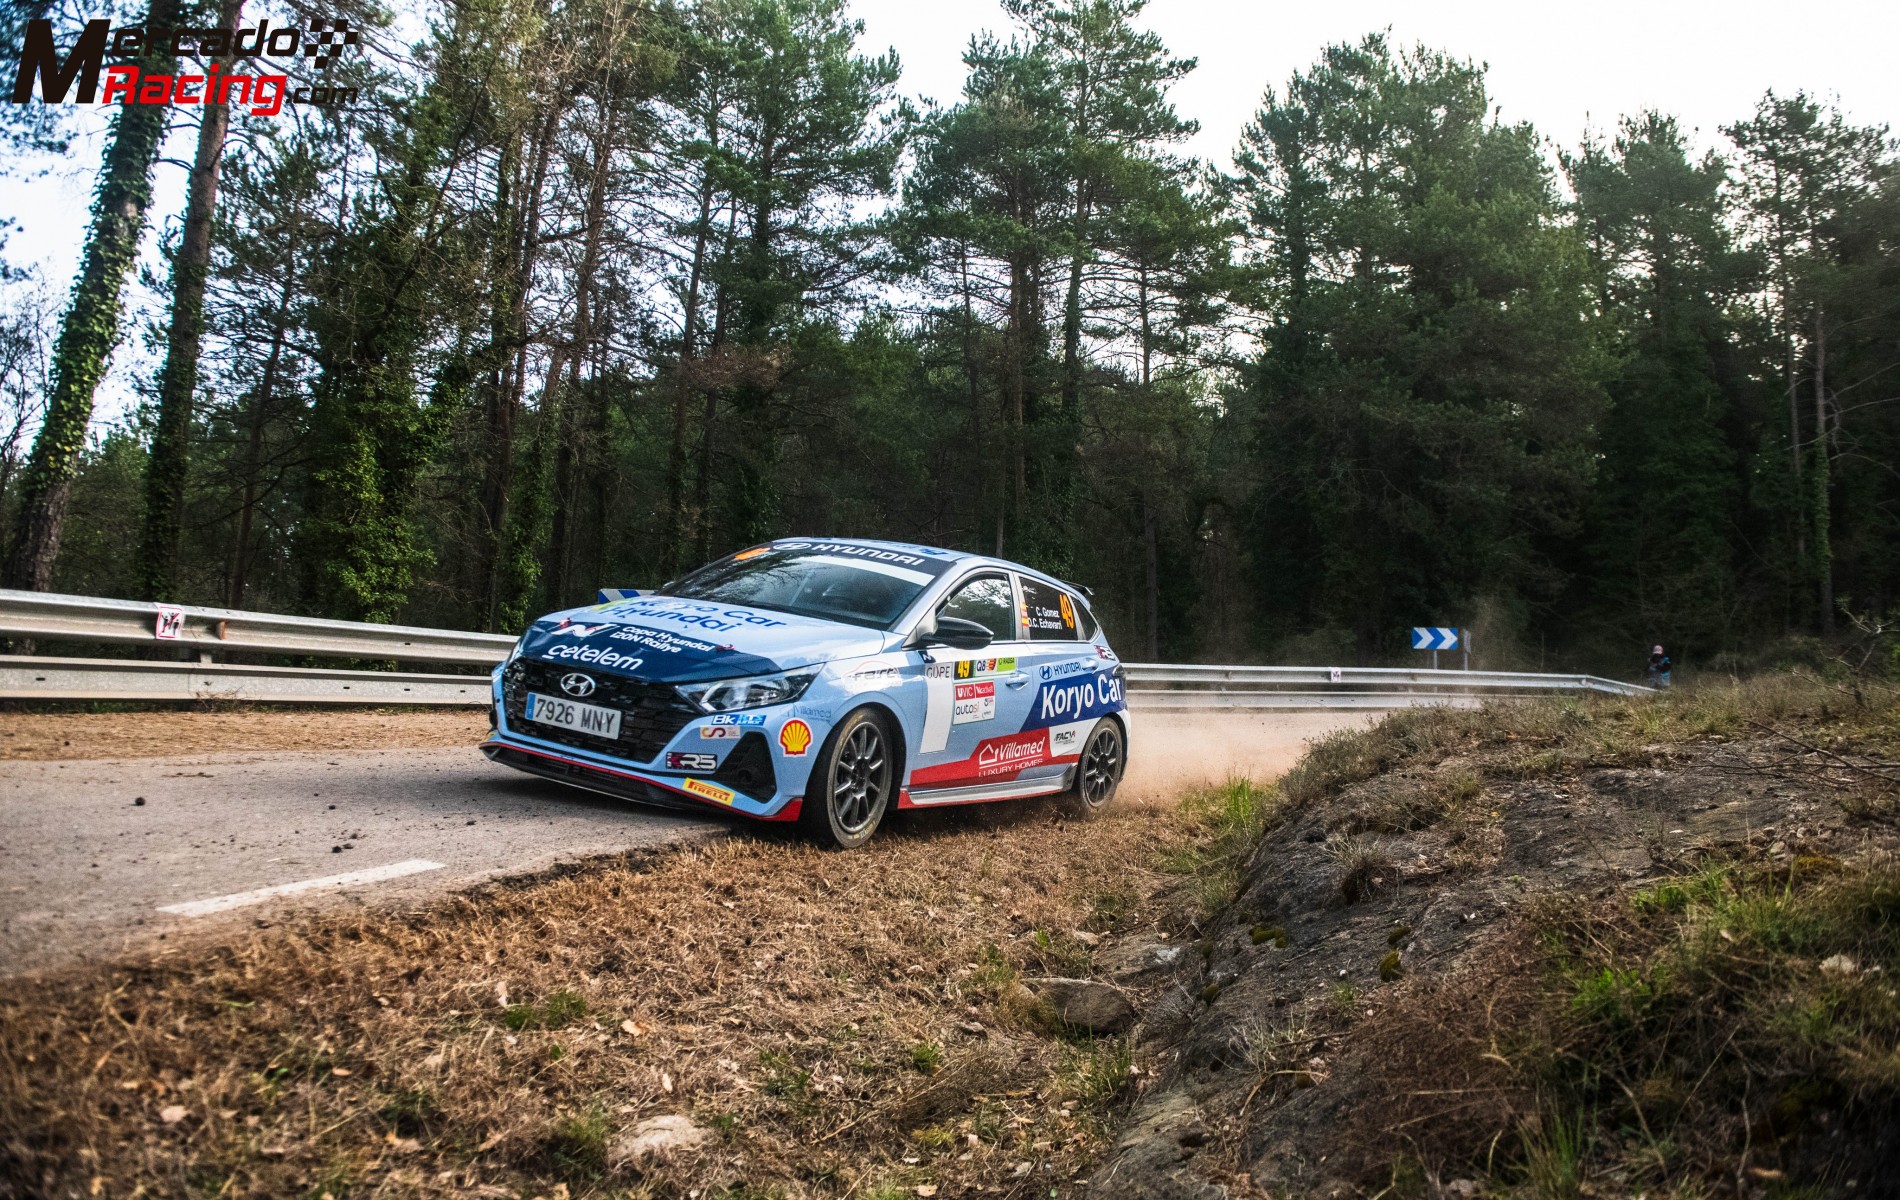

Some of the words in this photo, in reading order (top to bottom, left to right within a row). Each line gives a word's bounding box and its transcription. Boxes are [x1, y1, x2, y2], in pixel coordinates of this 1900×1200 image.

[811, 543, 925, 566] HYUNDAI
[599, 606, 743, 633] Hyundai
[724, 609, 787, 628] Car
[1035, 606, 1042, 617] C.
[1059, 594, 1074, 629] 49
[622, 626, 655, 638] Copa
[656, 632, 716, 653] Hyundai
[640, 637, 682, 653] Rallye
[547, 644, 644, 670] cetelem
[1053, 661, 1082, 676] HYUNDAI
[957, 661, 971, 678] 49
[1041, 682, 1095, 720] Koryo
[1098, 674, 1122, 705] Car
[535, 698, 576, 726] 7926
[581, 707, 615, 734] MNY
[1000, 737, 1046, 760] Villamed
[687, 780, 731, 802] PIRELLI
